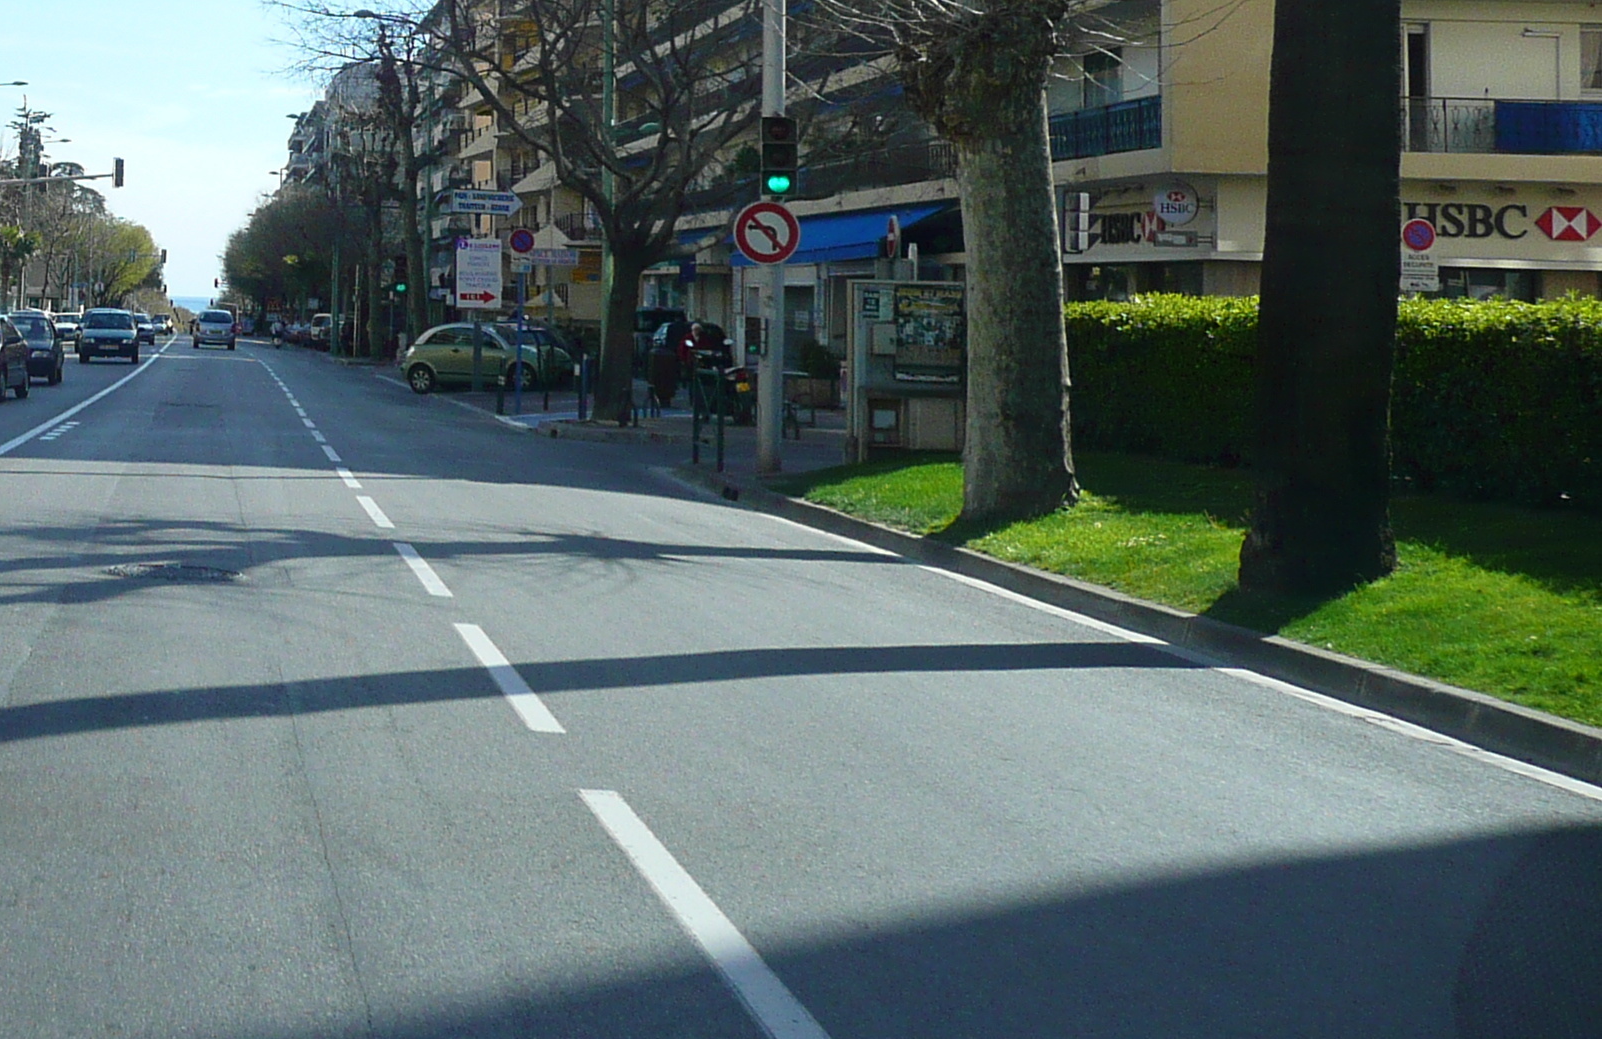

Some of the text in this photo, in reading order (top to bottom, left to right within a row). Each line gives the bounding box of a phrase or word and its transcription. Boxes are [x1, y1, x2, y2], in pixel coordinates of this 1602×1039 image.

[1160, 202, 1194, 215] HSBC
[1403, 202, 1528, 239] HSBC
[1100, 211, 1142, 243] HSBC
